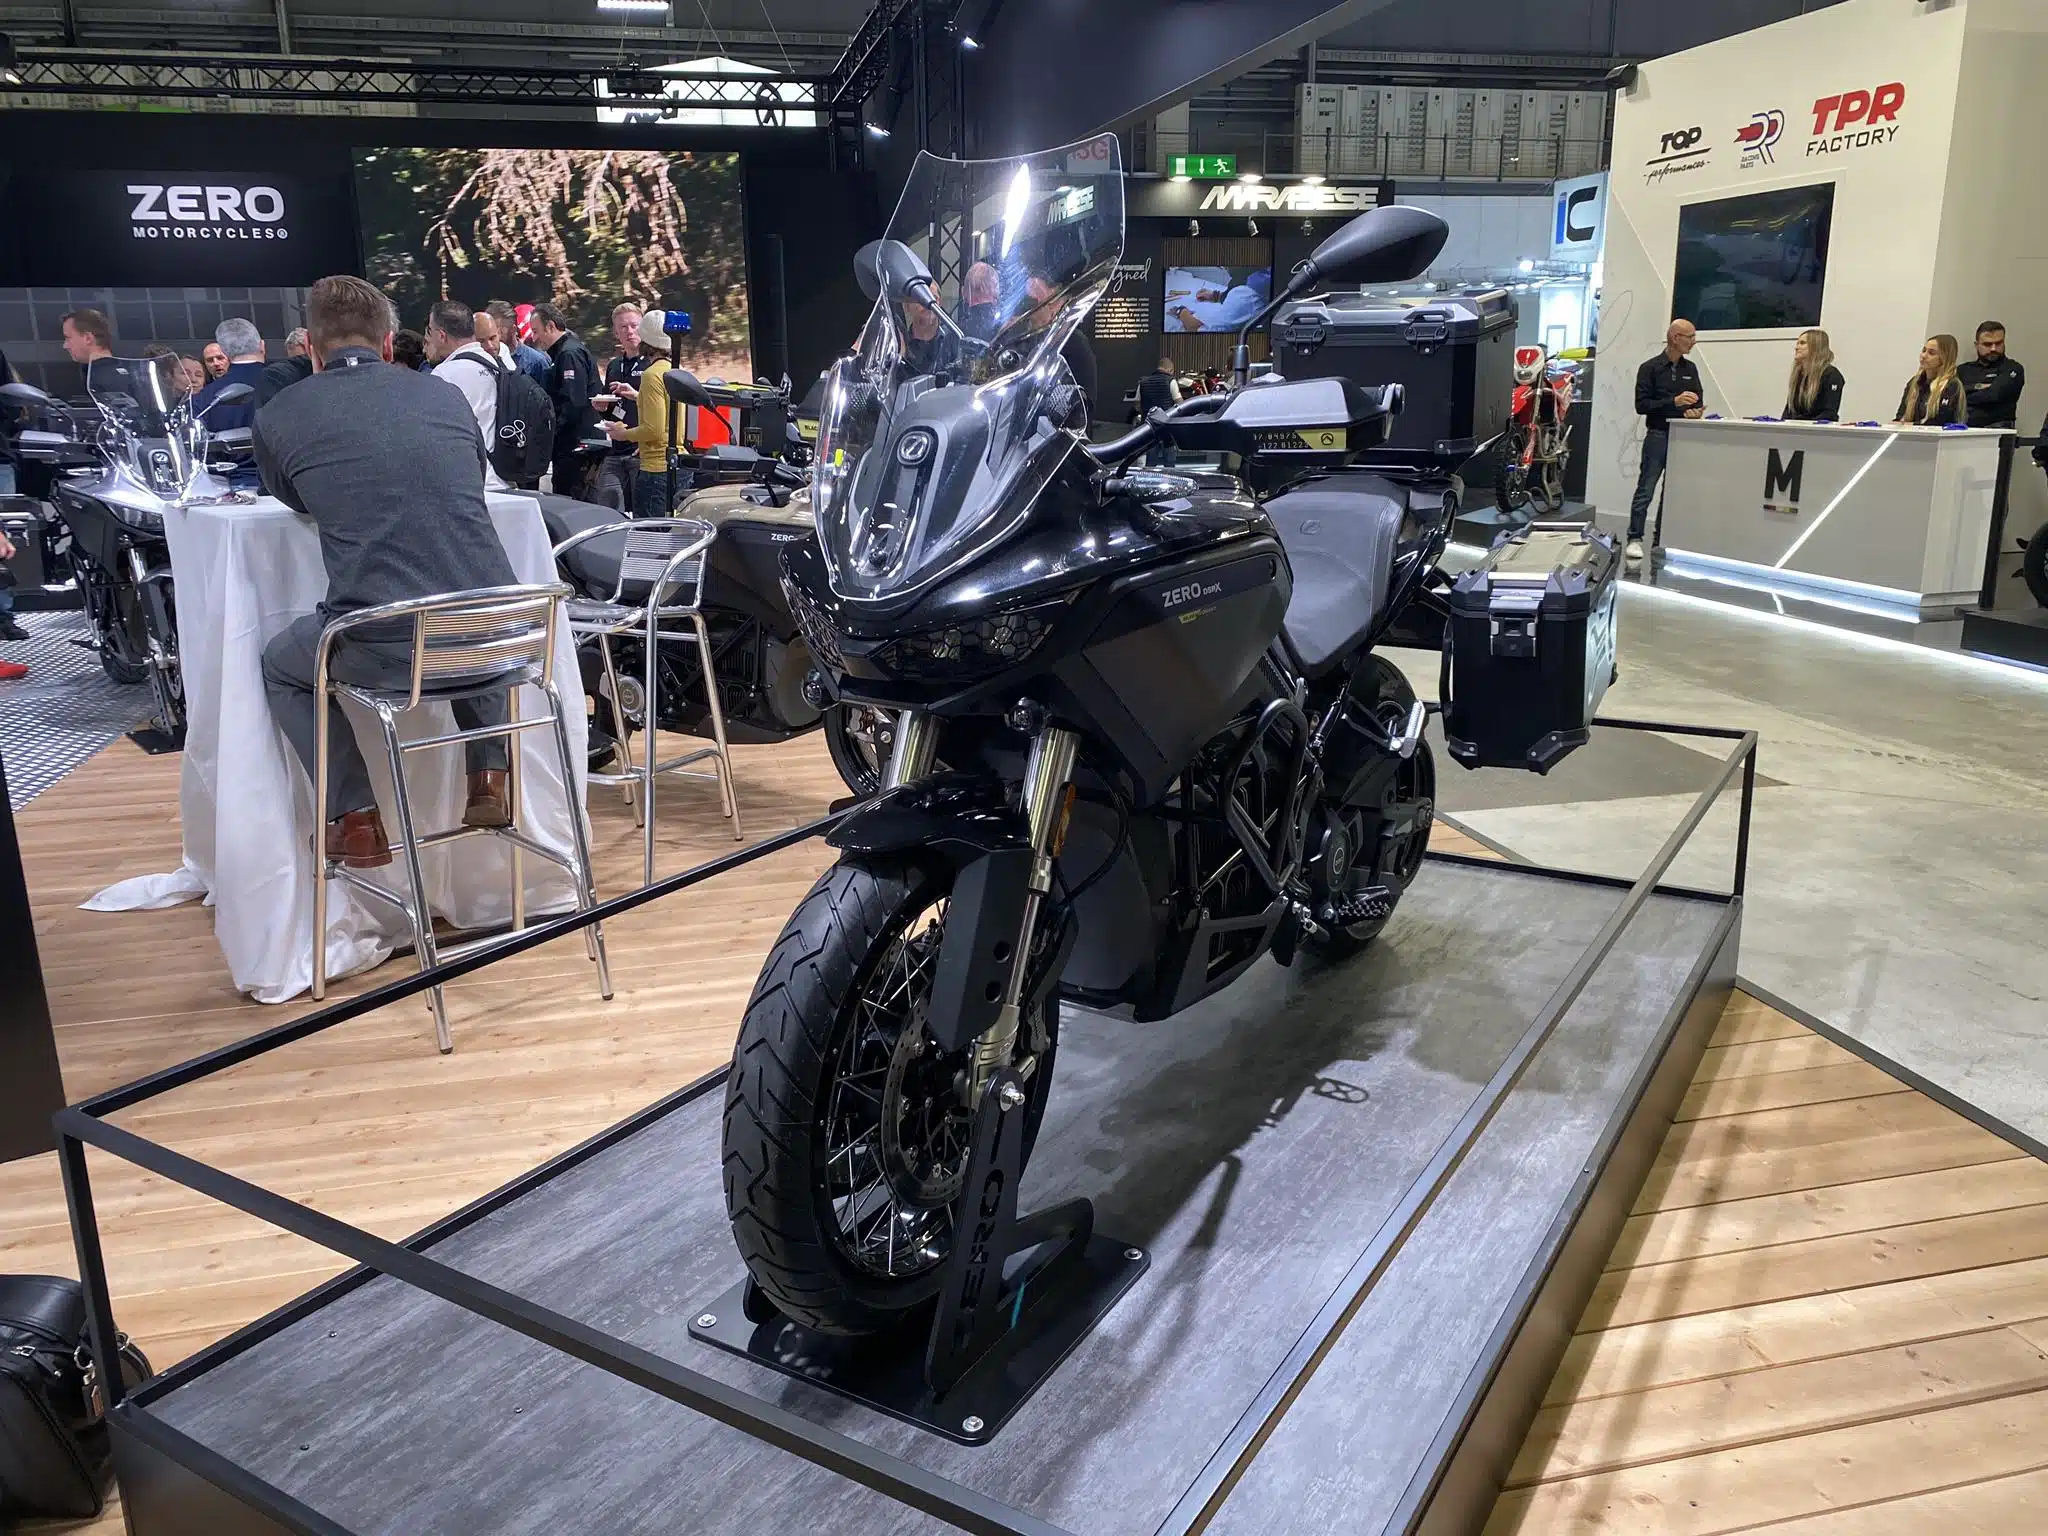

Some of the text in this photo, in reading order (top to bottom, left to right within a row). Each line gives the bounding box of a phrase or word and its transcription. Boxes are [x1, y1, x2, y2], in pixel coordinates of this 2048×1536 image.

[1812, 82, 1905, 135] TPR
[1660, 126, 1702, 154] TOP
[1806, 125, 1900, 157] FACTORY
[126, 185, 285, 222] ZERO
[1763, 448, 1804, 502] M
[1162, 583, 1201, 608] ZERO
